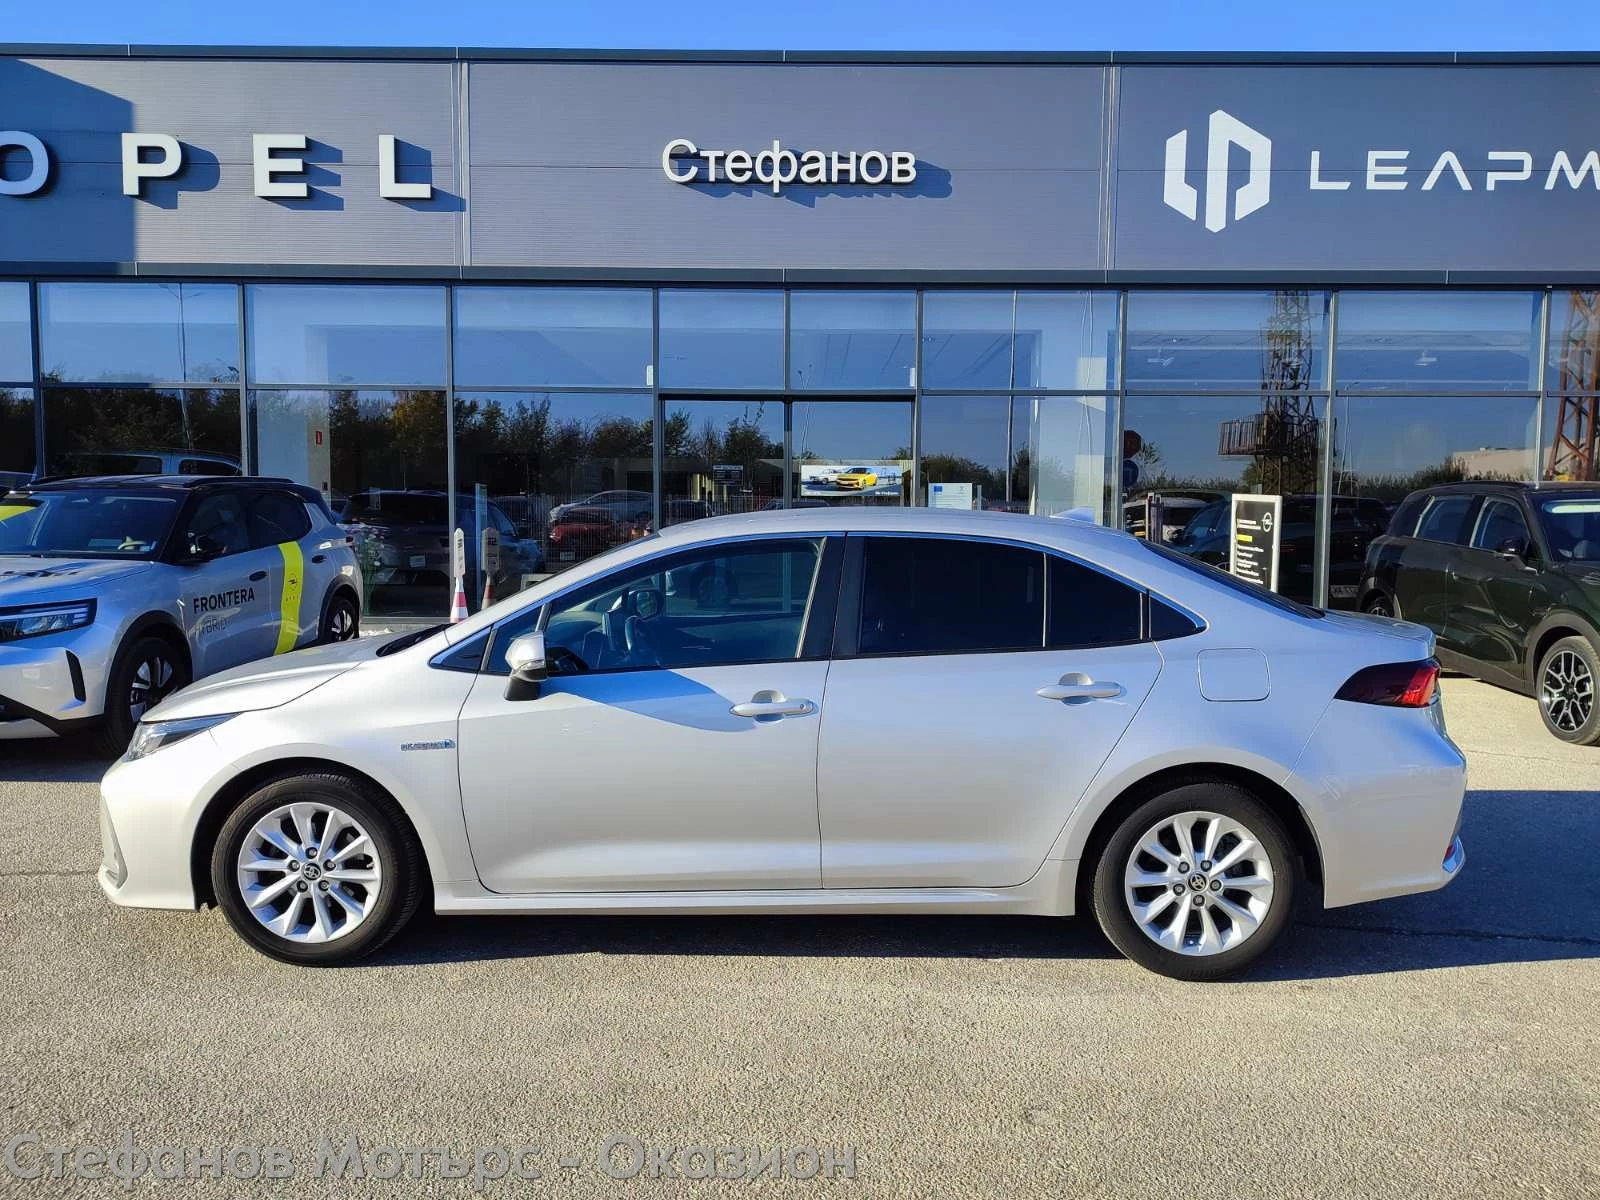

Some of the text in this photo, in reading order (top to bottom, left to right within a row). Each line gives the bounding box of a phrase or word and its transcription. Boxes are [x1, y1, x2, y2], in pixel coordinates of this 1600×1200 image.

[0, 130, 432, 199] OPEL
[662, 138, 917, 193] Стефанов
[193, 587, 255, 614] FRONTERA
